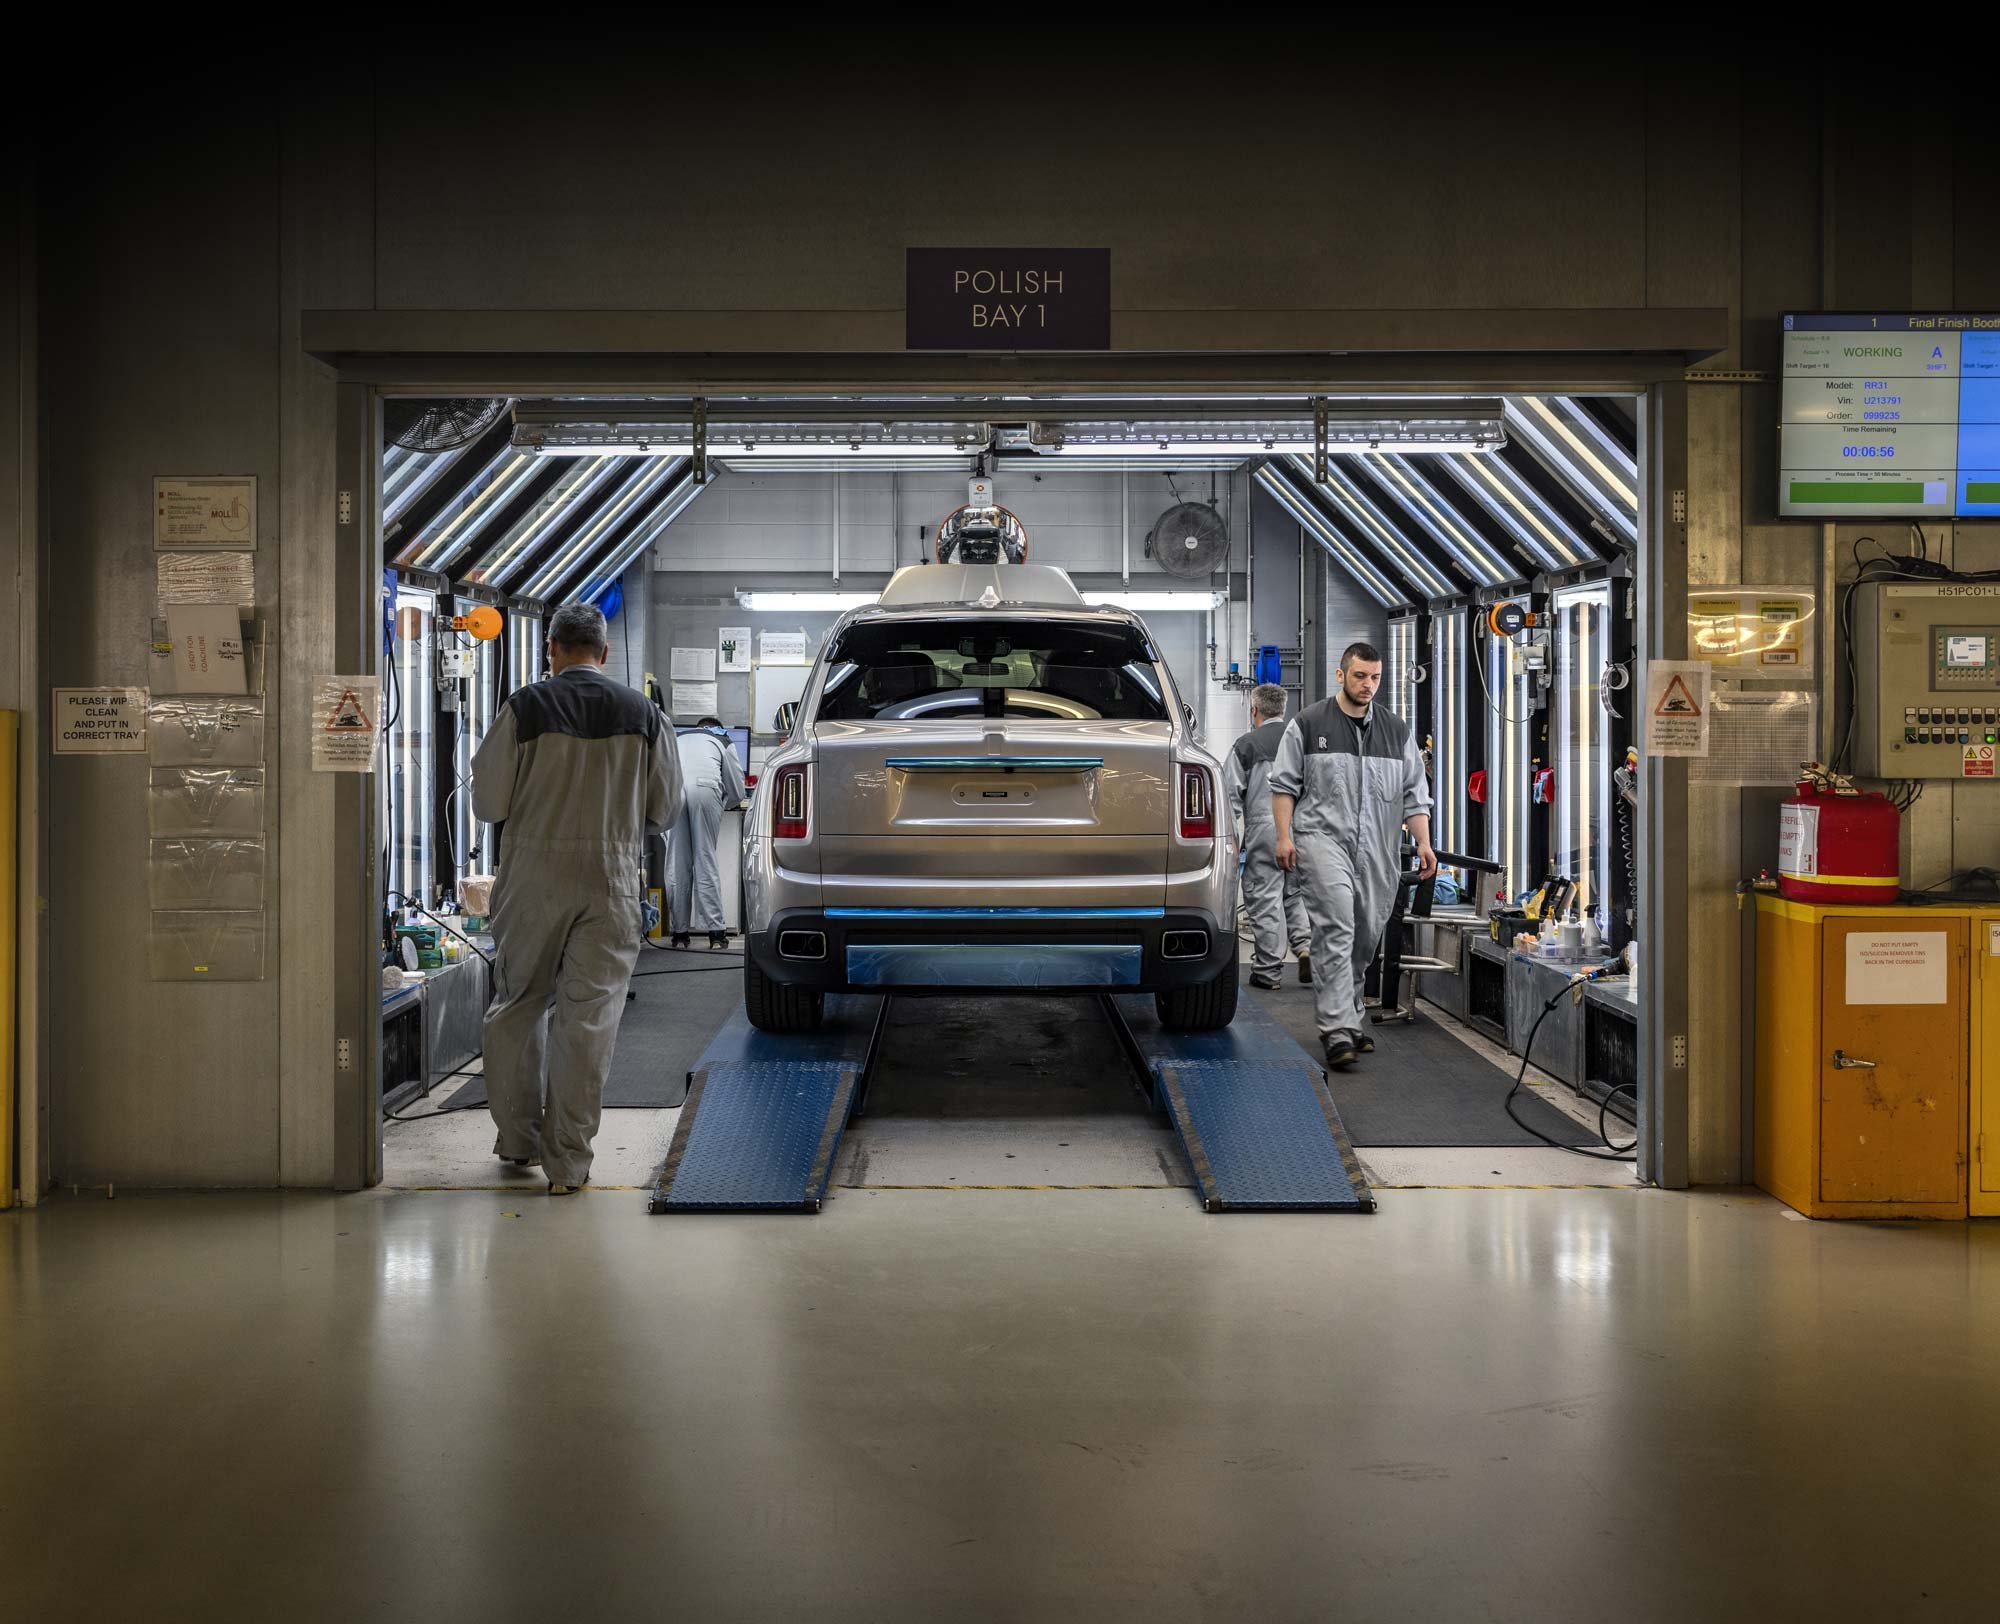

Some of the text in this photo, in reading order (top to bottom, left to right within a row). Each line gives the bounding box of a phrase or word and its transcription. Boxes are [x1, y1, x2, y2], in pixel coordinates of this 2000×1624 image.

[955, 270, 1063, 294] POLISH
[973, 304, 1045, 327] BAY 1
[1871, 318, 1877, 328] 1
[1909, 318, 1935, 328] Final
[1938, 318, 1969, 328] Finish
[1844, 347, 1903, 358] WORKING
[1932, 347, 1942, 358] A
[1843, 446, 1894, 457] 00:06:56
[63, 732, 139, 740] CORRECT TRAY
